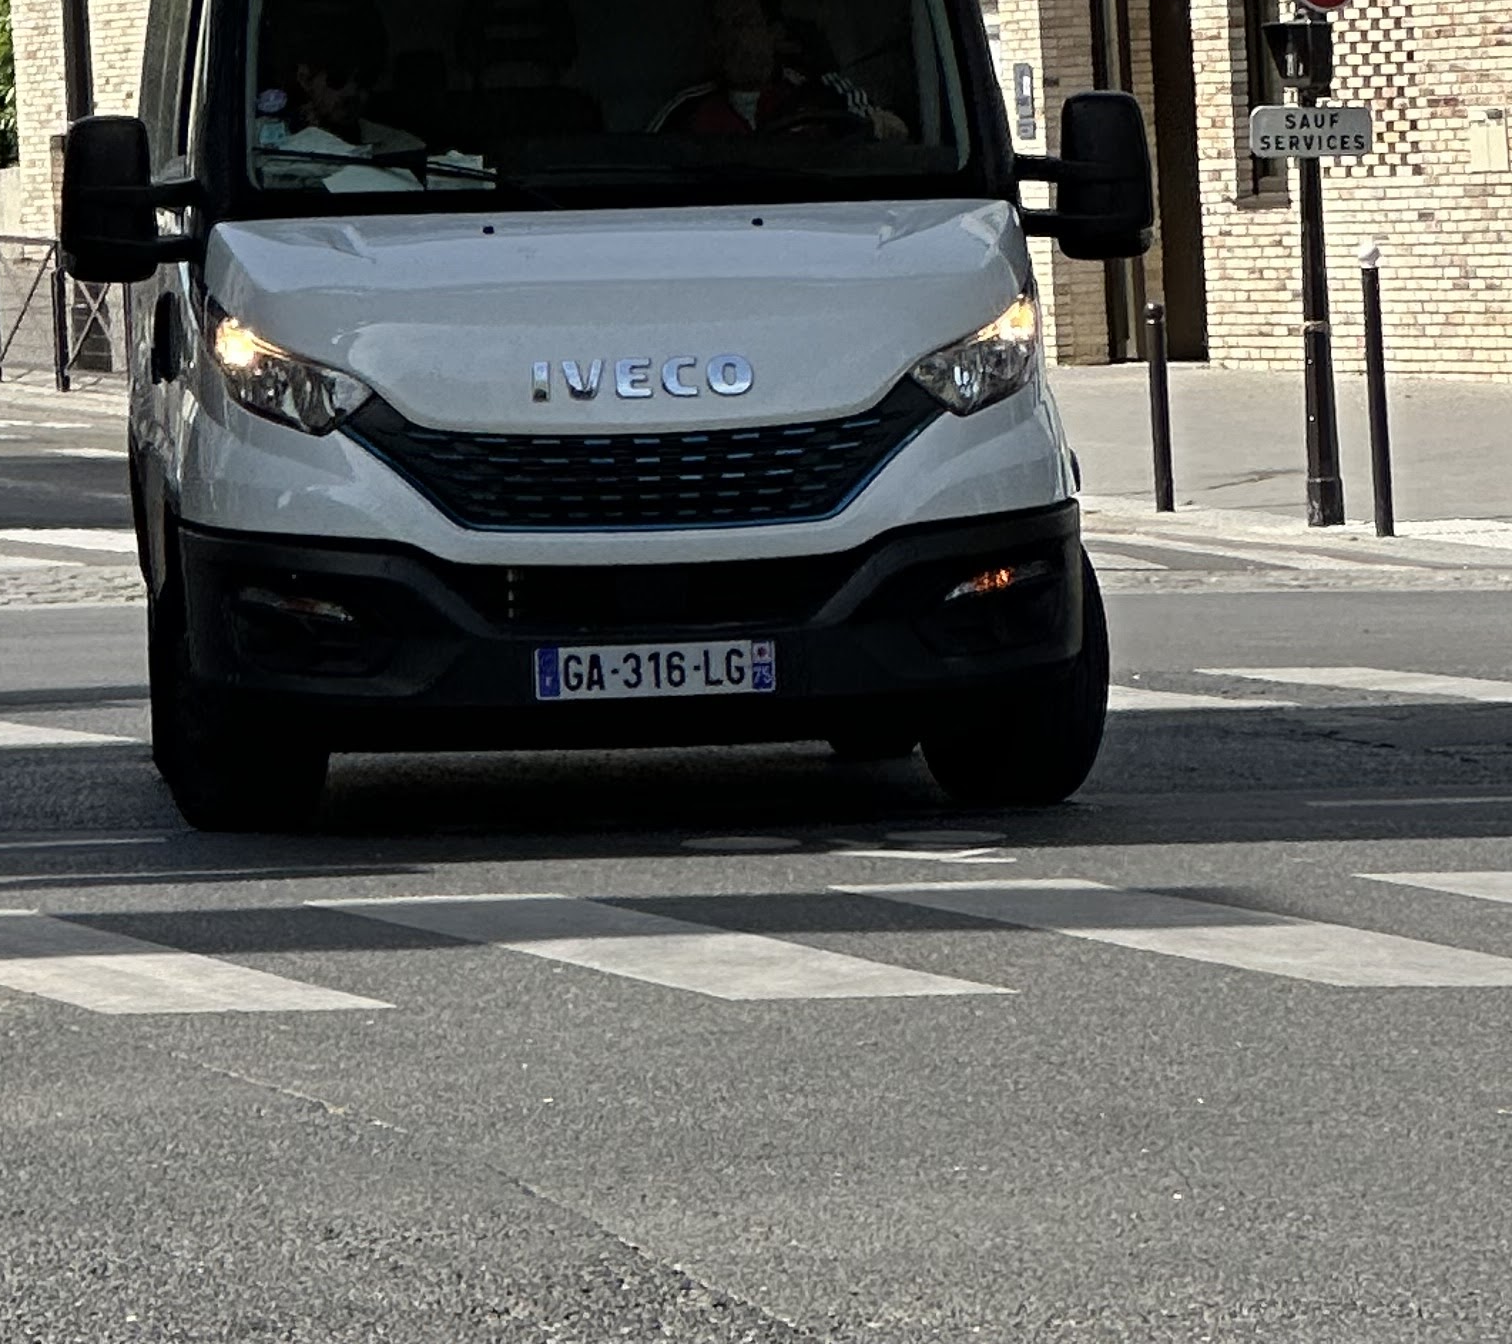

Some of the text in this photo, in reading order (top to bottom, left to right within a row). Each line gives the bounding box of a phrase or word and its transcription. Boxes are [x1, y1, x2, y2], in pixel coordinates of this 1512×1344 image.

[1285, 113, 1340, 129] SAUF
[1260, 133, 1365, 151] SERVICES
[532, 353, 754, 402] IVECO
[563, 649, 745, 691] GA-316-LG
